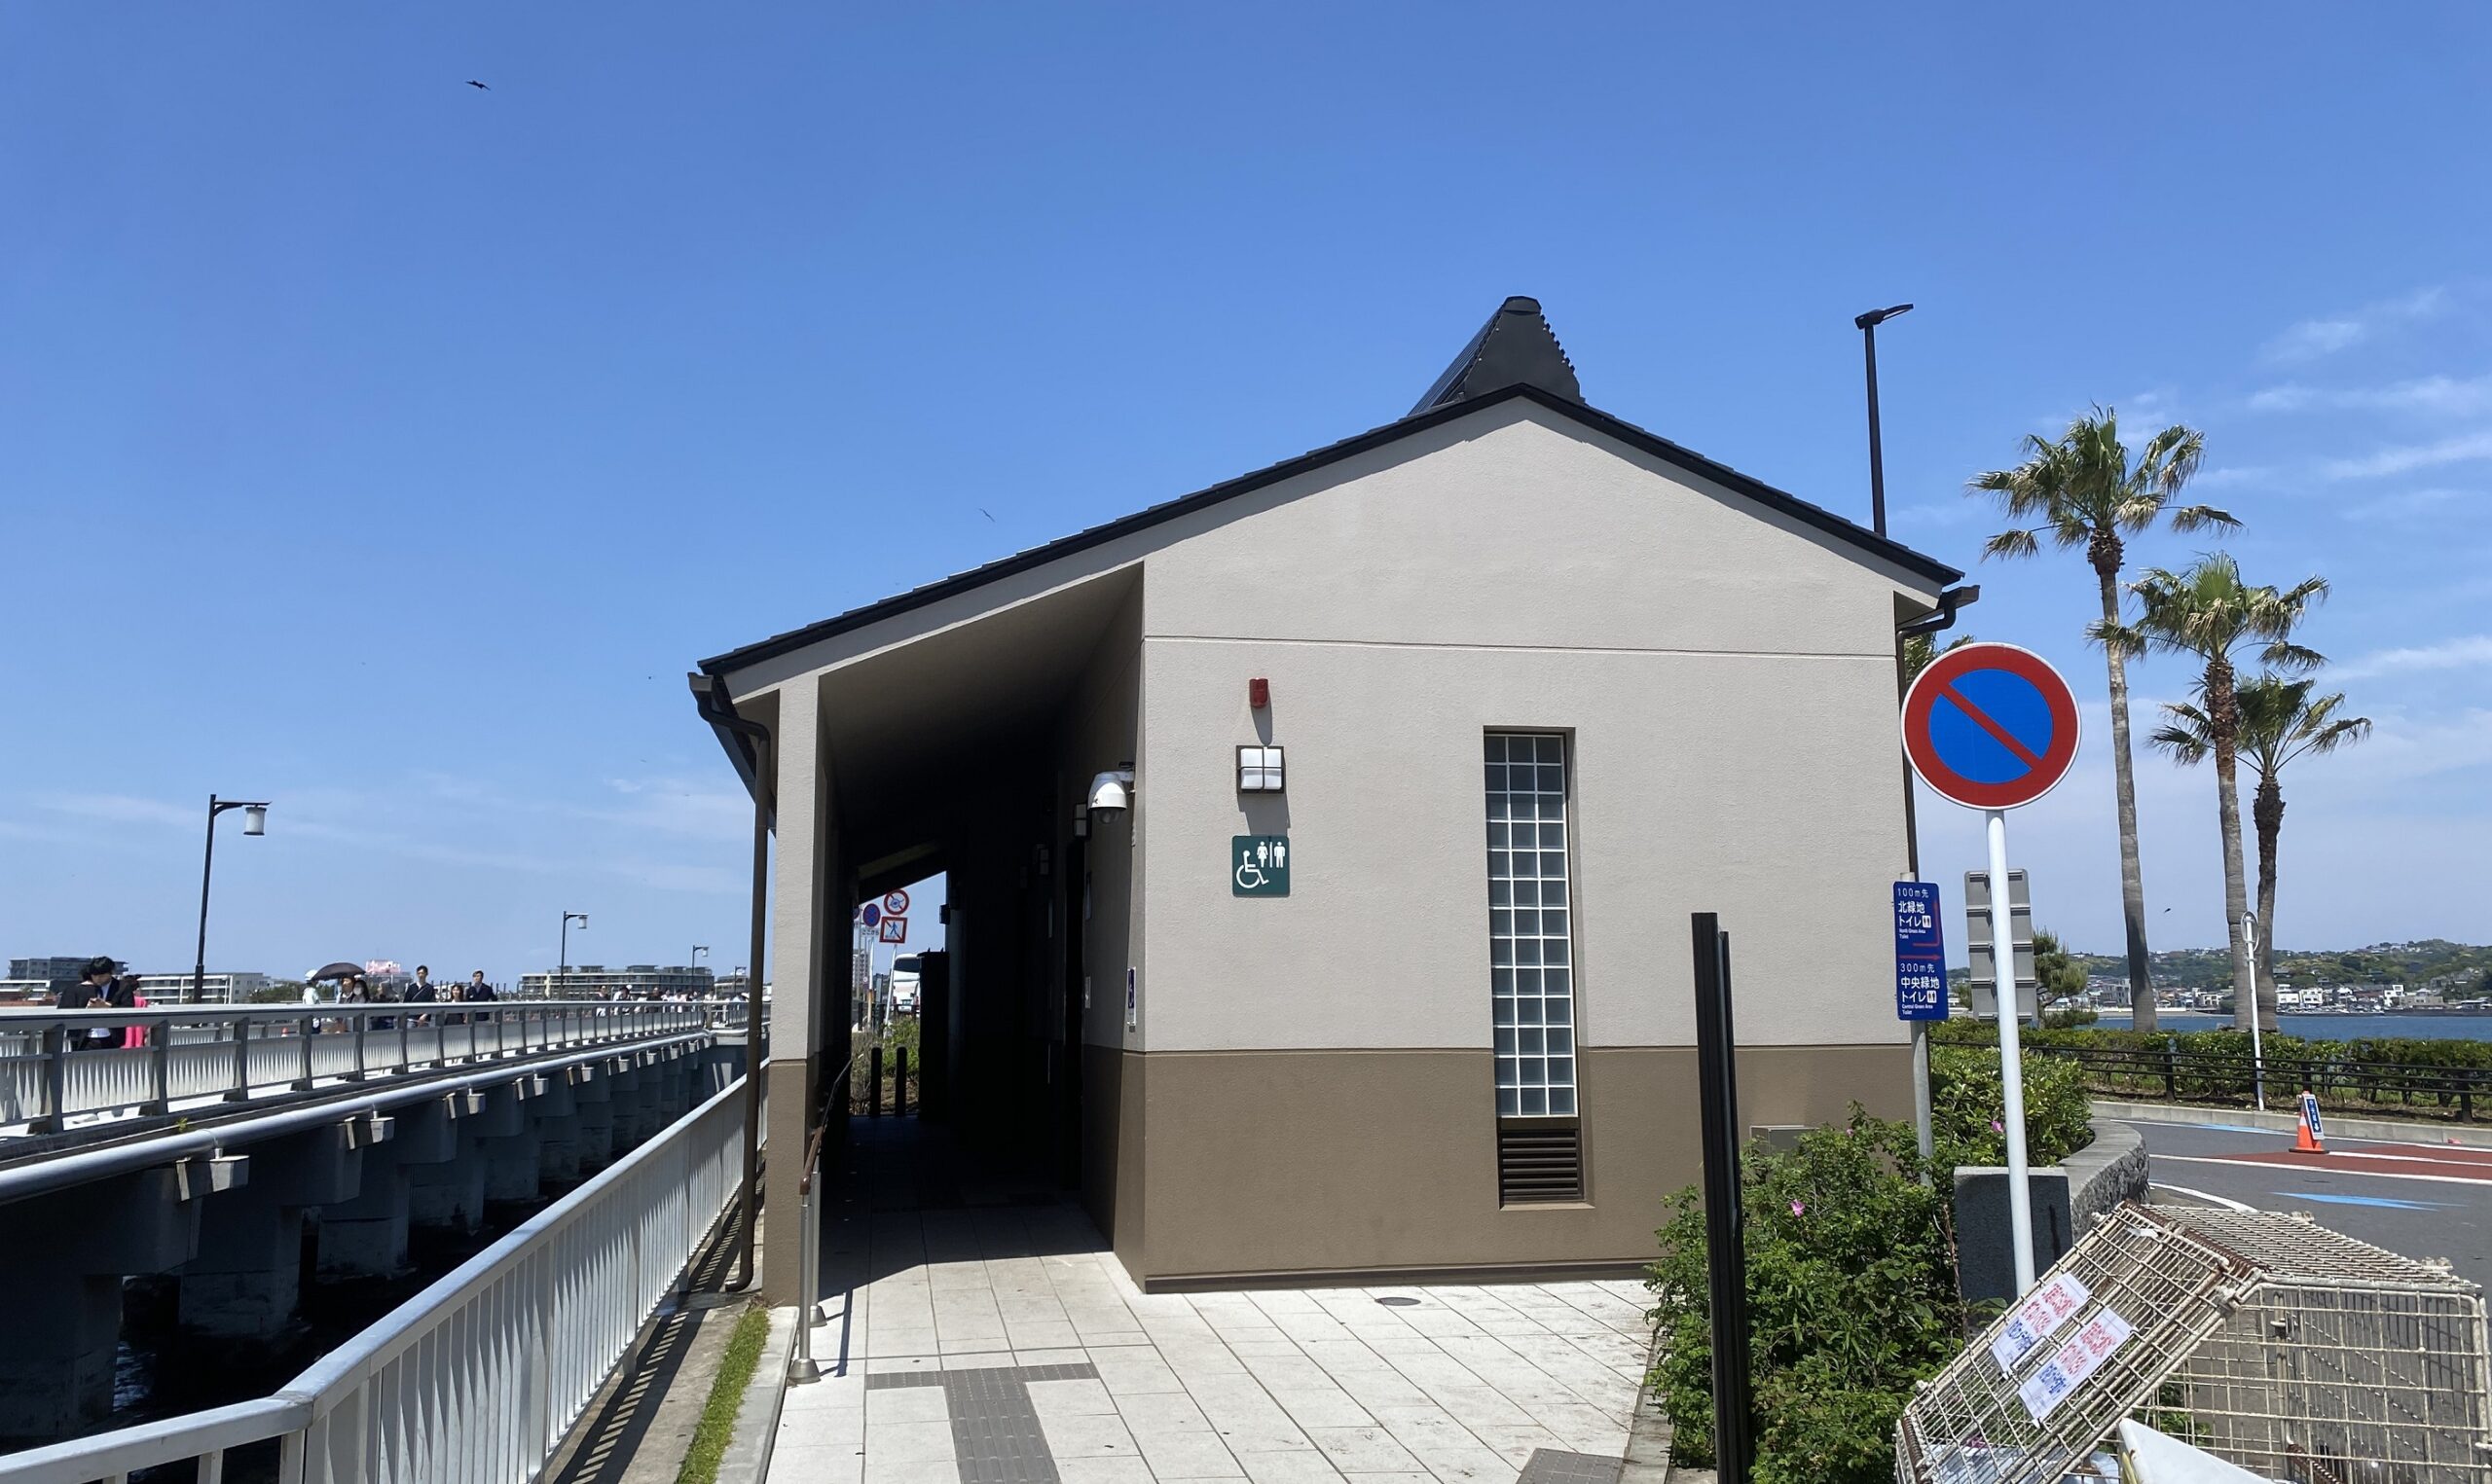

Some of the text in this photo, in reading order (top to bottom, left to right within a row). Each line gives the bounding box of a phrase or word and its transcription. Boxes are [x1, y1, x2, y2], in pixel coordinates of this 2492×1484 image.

[1897, 900, 1925, 914] 北緑地
[1899, 915, 1922, 927] トイレ
[1900, 976, 1940, 989] 中央緑地
[1901, 991, 1926, 1003] トイレ
